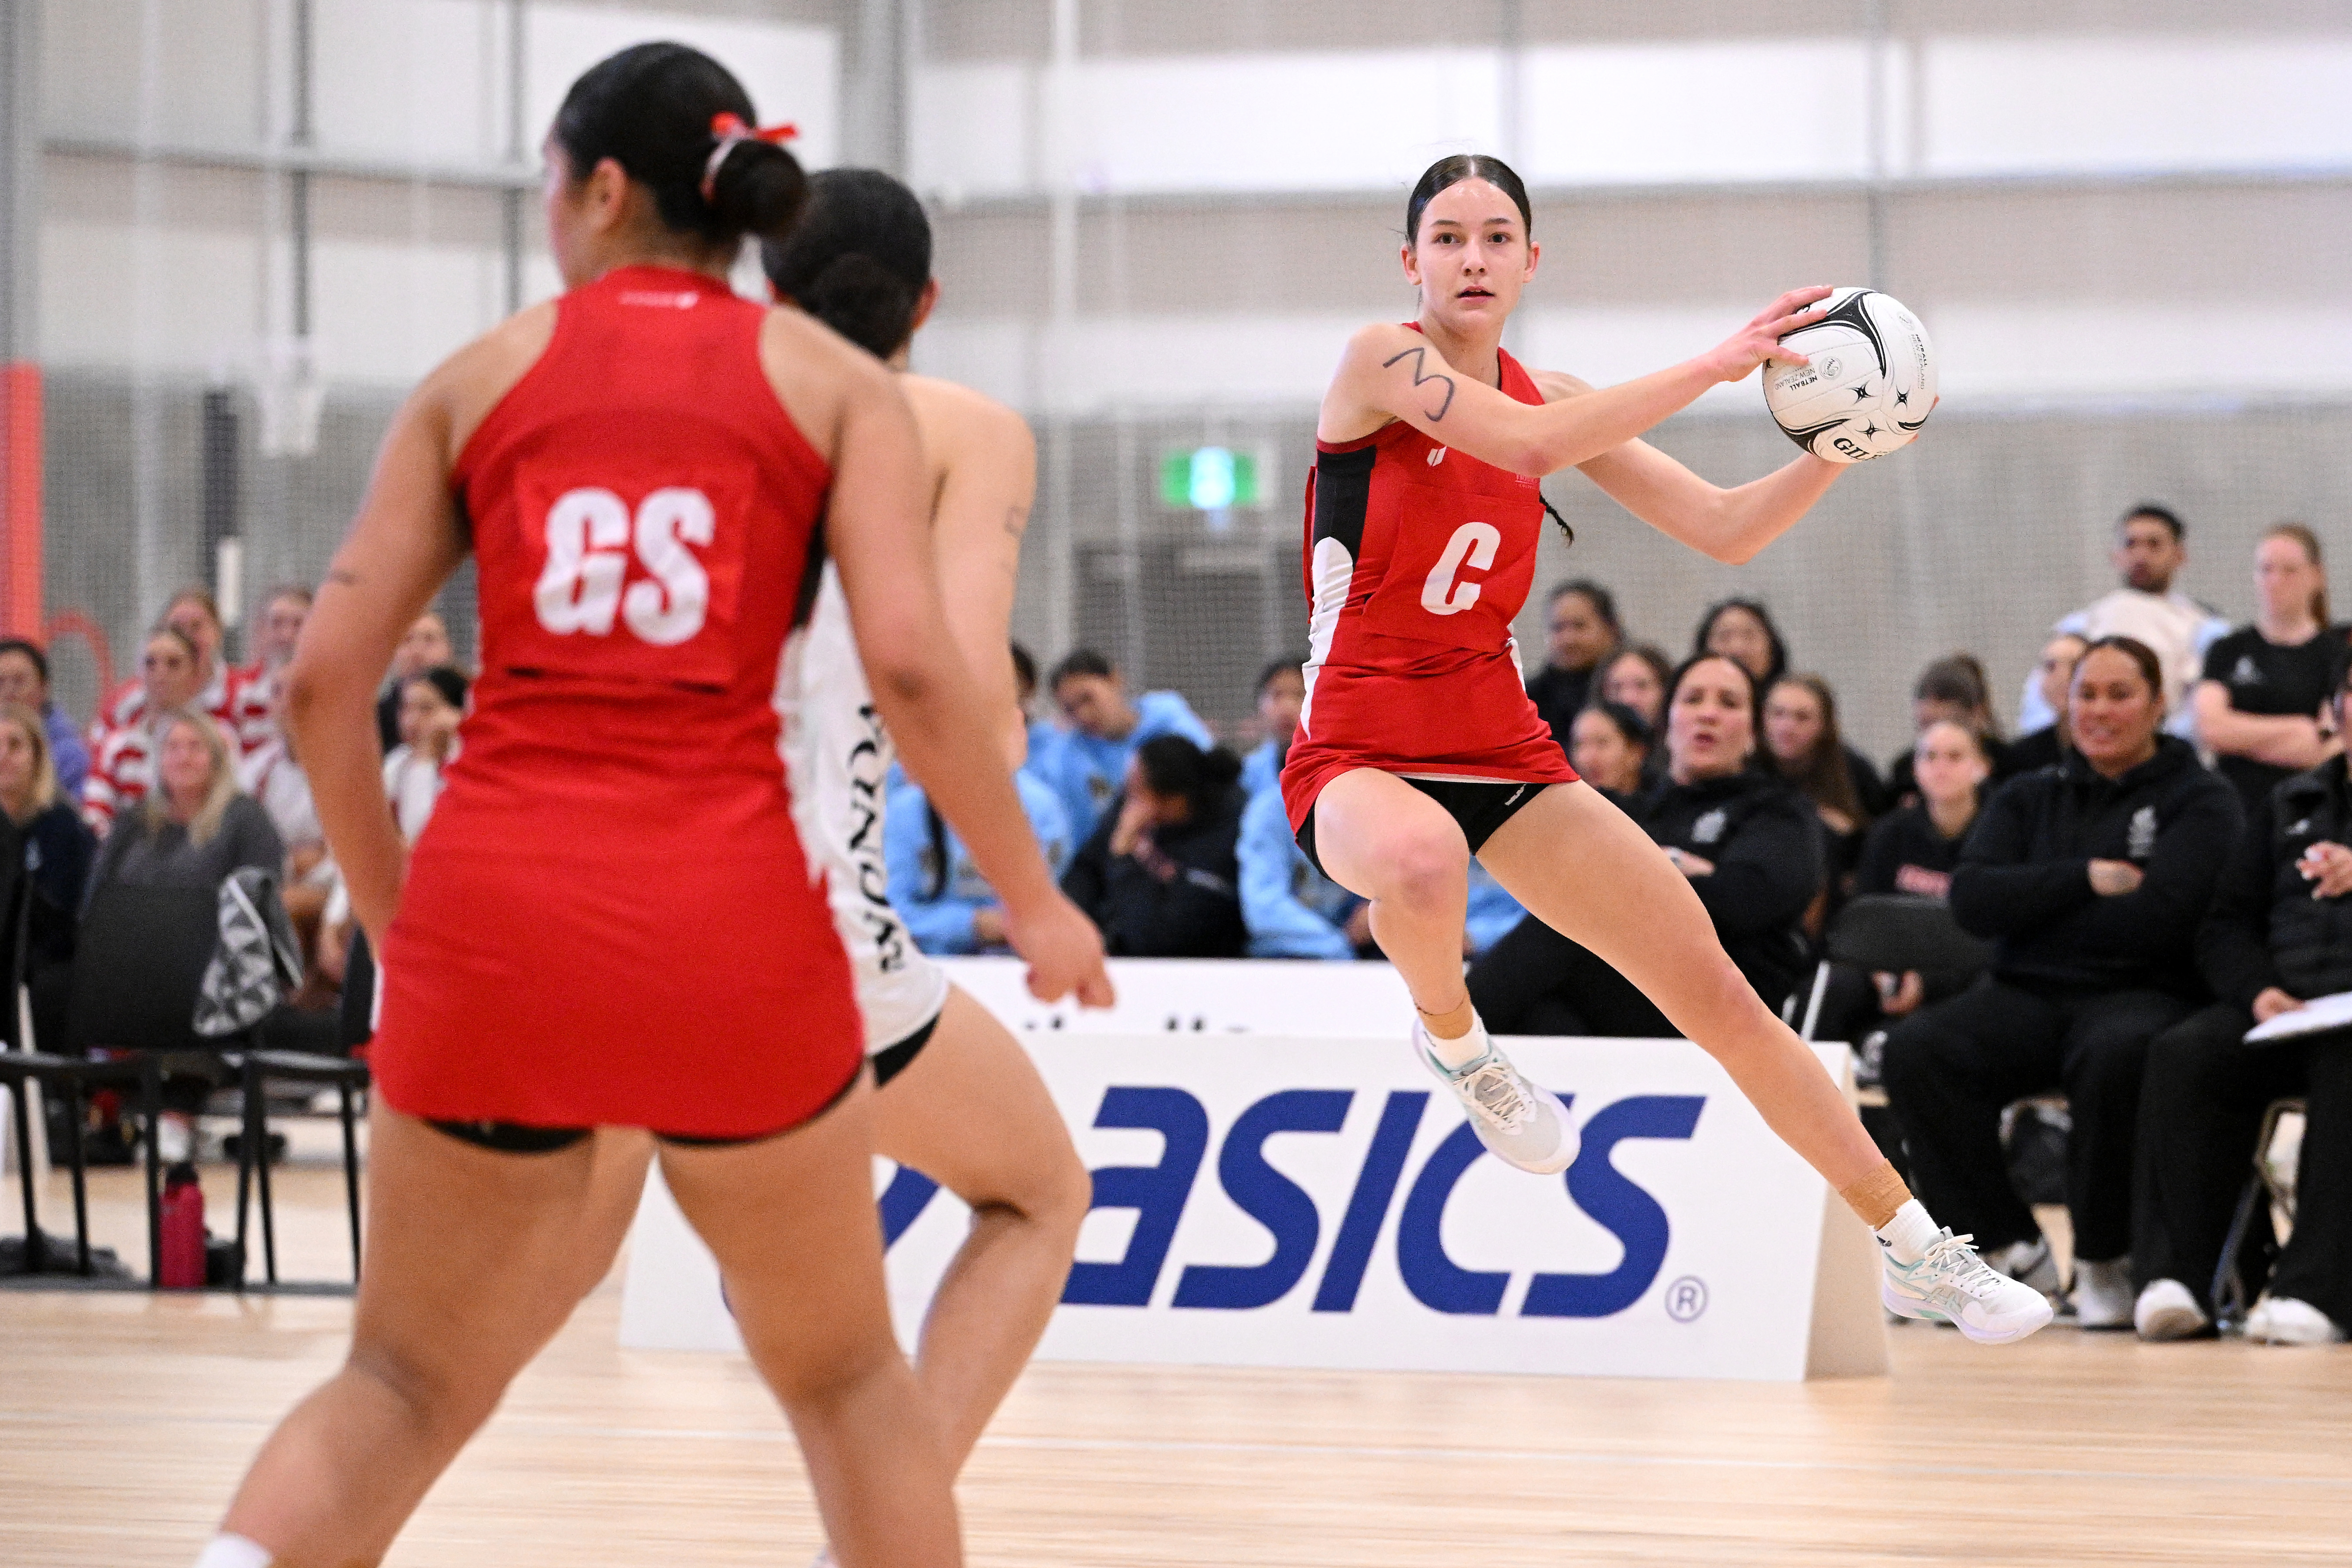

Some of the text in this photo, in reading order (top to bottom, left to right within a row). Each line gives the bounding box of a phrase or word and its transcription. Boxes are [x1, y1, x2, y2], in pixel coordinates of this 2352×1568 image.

[1915, 335, 1927, 367] NETBALL
[1383, 347, 1454, 421] 3
[1775, 374, 1798, 390] ZEALAND
[1789, 375, 1818, 391] NETBALL
[1800, 368, 1815, 378] NEW
[533, 487, 715, 646] GS
[1421, 522, 1500, 615] C
